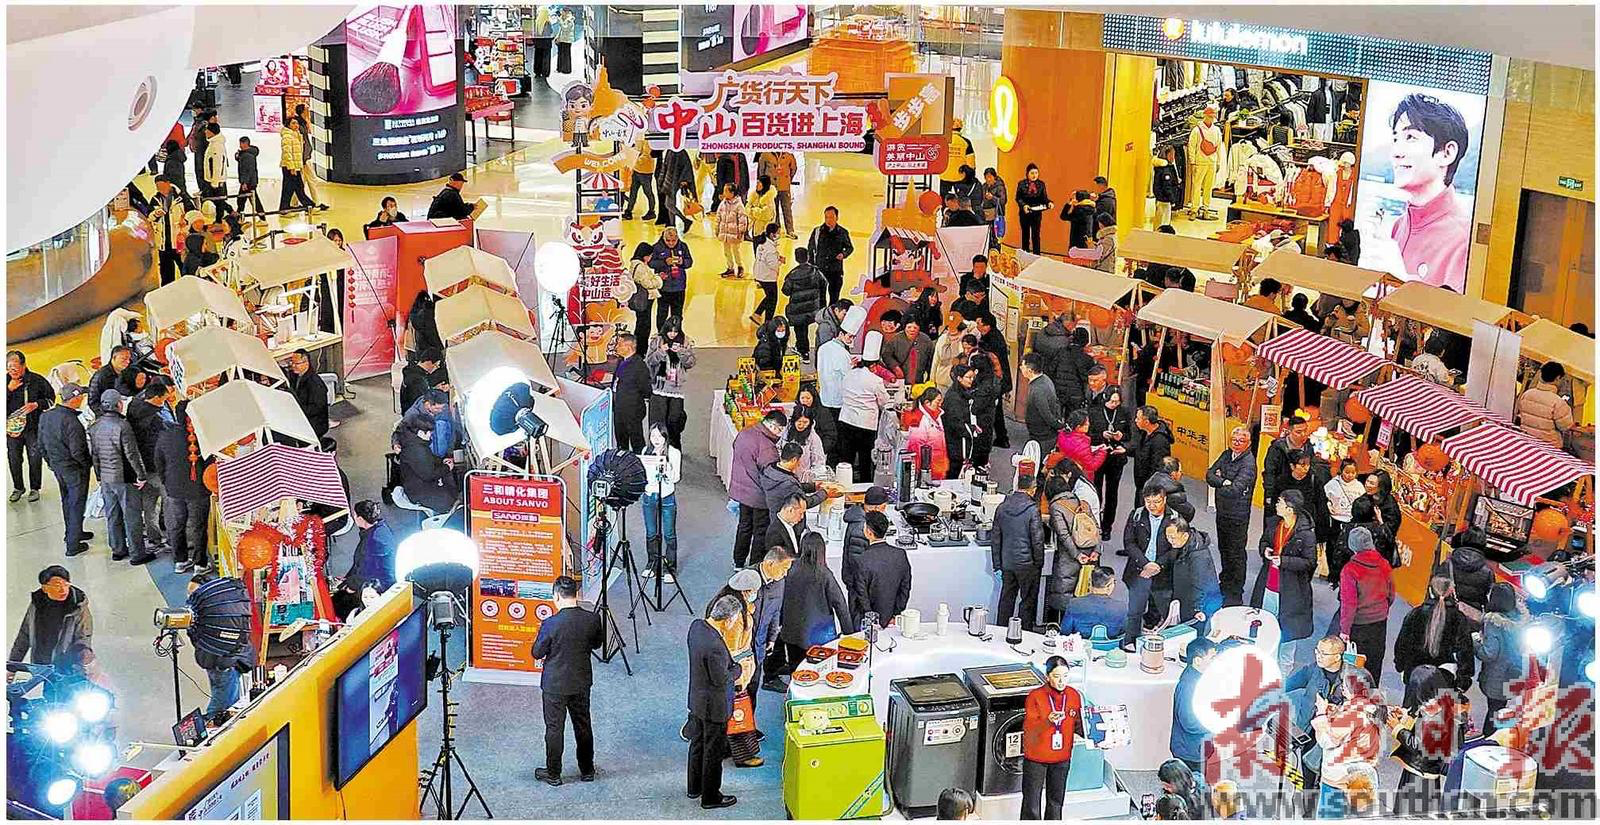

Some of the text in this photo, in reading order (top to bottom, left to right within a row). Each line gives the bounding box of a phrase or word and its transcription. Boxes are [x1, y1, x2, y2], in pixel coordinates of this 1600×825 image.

[1190, 19, 1308, 56] lululemon
[702, 75, 834, 112] 广货行天下
[658, 101, 863, 149] 中山百货进上海
[701, 141, 865, 150] ZHONGSHAN PRODUCTS, SHANGHAI BOUND
[483, 497, 549, 509] ABOUT SANVO
[1008, 735, 1018, 744] 12
